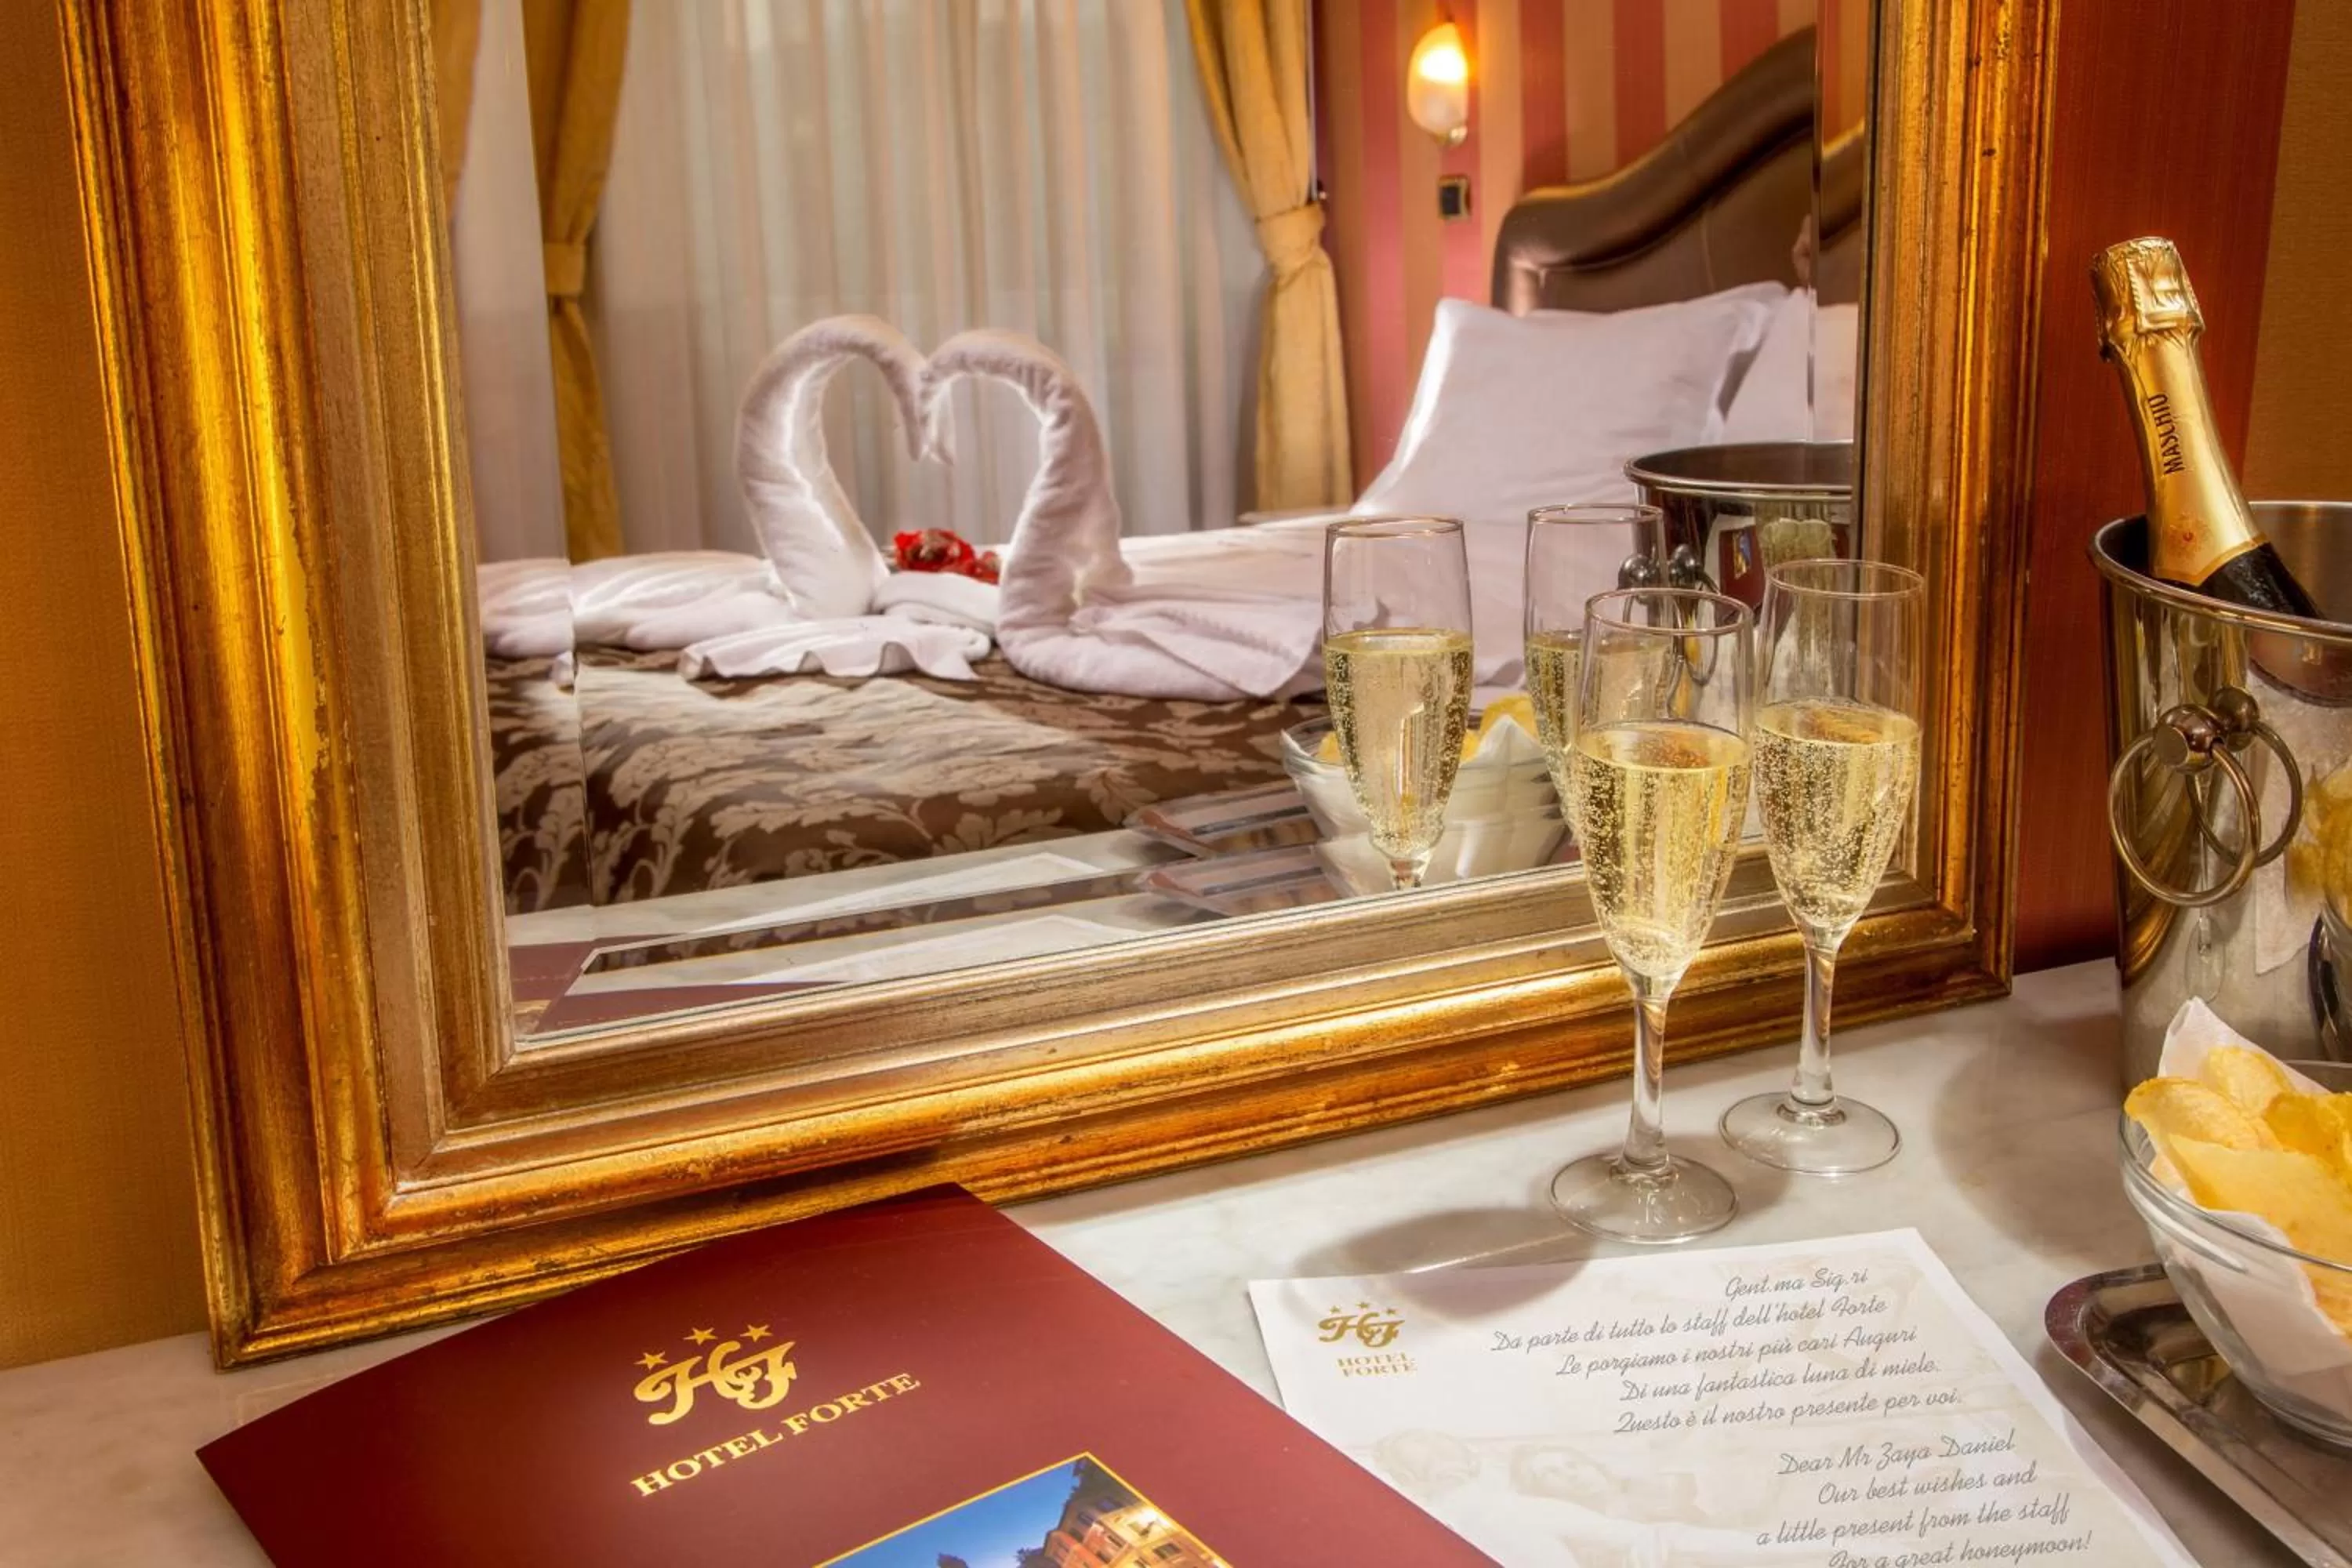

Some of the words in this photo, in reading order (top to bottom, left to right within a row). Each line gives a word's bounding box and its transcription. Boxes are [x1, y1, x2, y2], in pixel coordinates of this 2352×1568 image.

[1490, 1330, 1523, 1352] Da
[1526, 1325, 1579, 1354] parte
[1584, 1321, 1605, 1341] di
[1609, 1319, 1654, 1340] tutto
[1660, 1313, 1678, 1334] lo
[1682, 1307, 1730, 1338] staff
[1831, 1295, 1888, 1317] Forte
[1338, 1352, 1414, 1366] HOTEL
[1342, 1363, 1417, 1377] FORTE
[1555, 1353, 1581, 1376] Le
[1586, 1351, 1679, 1379] porgiamo
[1682, 1348, 1691, 1363] i
[1695, 1341, 1753, 1363] nostri
[1758, 1337, 1792, 1363] più
[1797, 1332, 1838, 1352] cari
[1843, 1326, 1917, 1352] Auguri
[1620, 1380, 1646, 1402] Di
[1652, 1381, 1692, 1398] una
[1695, 1372, 1795, 1401] fantastica
[1802, 1363, 1849, 1385] luna
[1856, 1358, 1878, 1377] di
[630, 1428, 783, 1497] HOTEL
[783, 1373, 921, 1436] FORTE
[1612, 1411, 1682, 1435] Questo
[1685, 1411, 1697, 1426] è
[1702, 1404, 1719, 1426] il
[1722, 1403, 1785, 1423] nostro
[1790, 1392, 1878, 1424] presente
[1885, 1396, 1920, 1415] per
[1775, 1452, 1834, 1475] Dear
[1838, 1445, 1873, 1468] Mr
[1938, 1428, 2016, 1458] Daniel
[1817, 1483, 1859, 1505] Our
[1866, 1474, 1910, 1500] best
[1914, 1471, 1987, 1496] wishes
[1992, 1461, 2038, 1487] and
[1755, 1531, 1770, 1545] a
[1776, 1518, 1827, 1544] little
[1831, 1510, 1914, 1546] present
[1918, 1507, 1971, 1538] from
[1977, 1499, 2013, 1523] the
[2018, 1492, 2070, 1524] staff
[1875, 1552, 1893, 1568] a
[1895, 1542, 1954, 1568] great
[1959, 1530, 2092, 1564] honeymoon!
